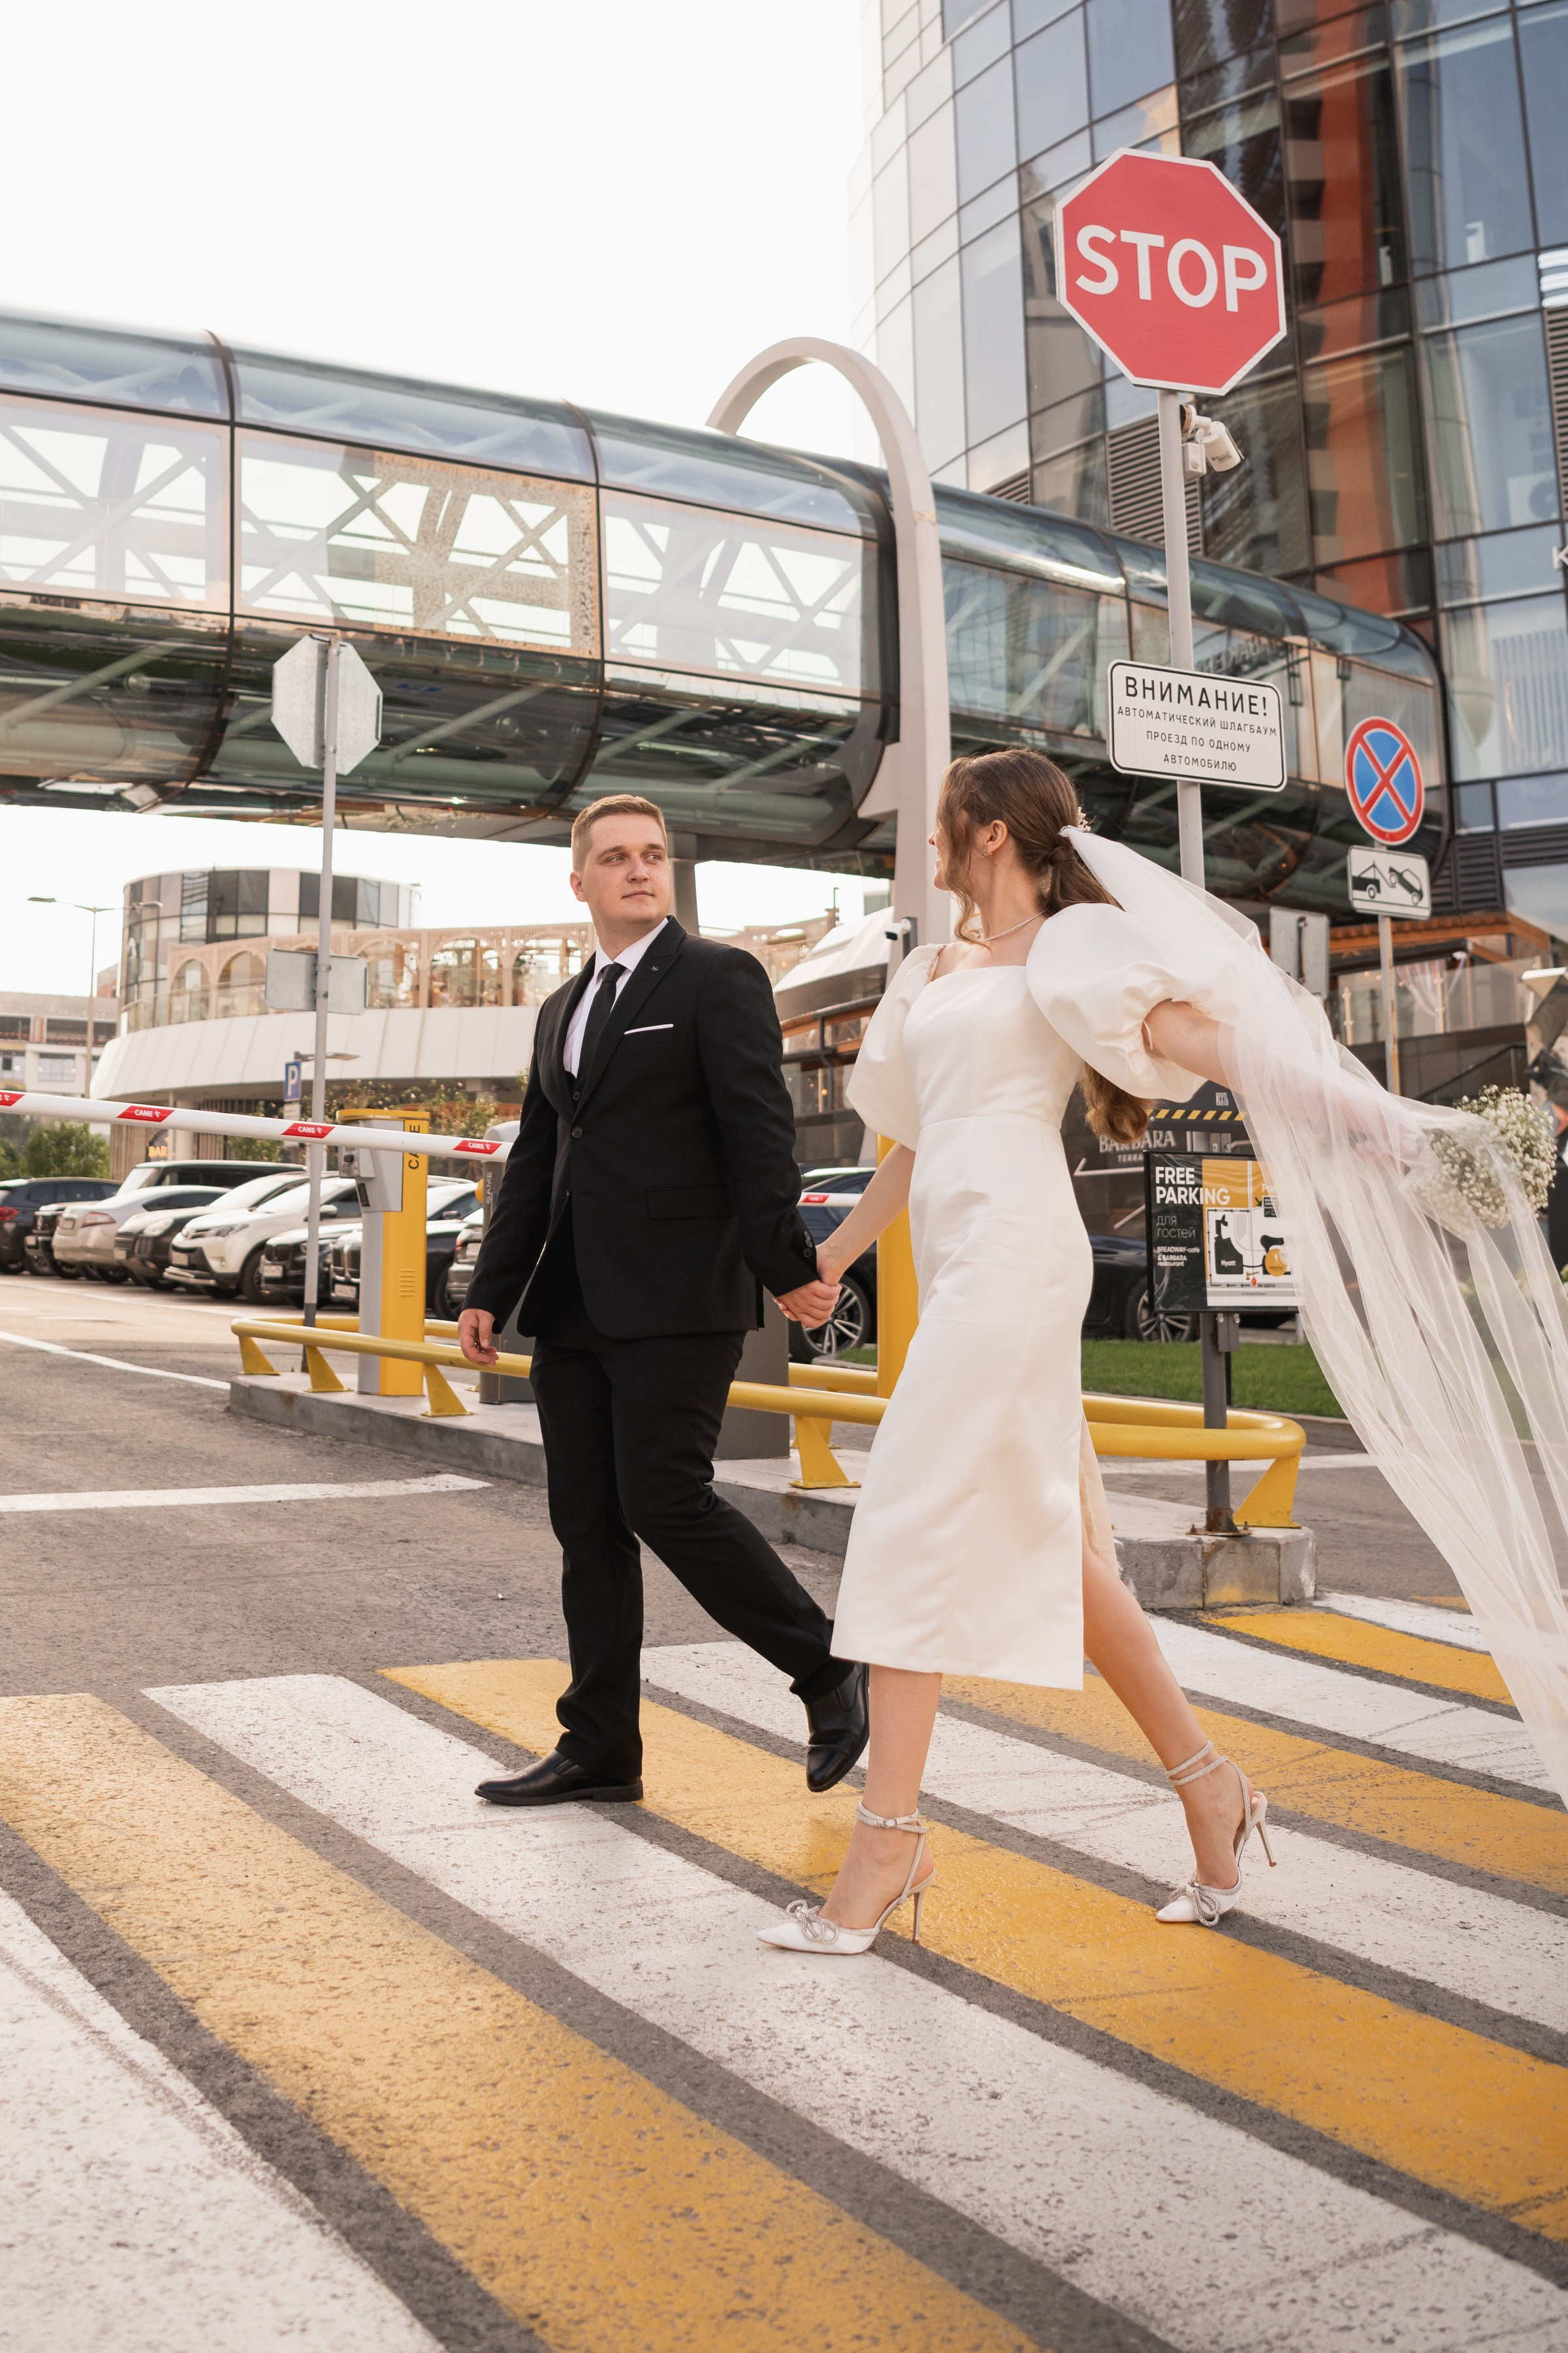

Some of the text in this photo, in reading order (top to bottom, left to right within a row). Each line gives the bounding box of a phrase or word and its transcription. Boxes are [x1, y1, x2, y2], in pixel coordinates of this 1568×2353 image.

[1075, 224, 1268, 312] STOP
[1125, 675, 1267, 717] ВНИМАНИЕ!
[1117, 706, 1277, 737] АВТОМАТИЧЕСКИЙ ШЛАГБАУМ
[1147, 730, 1251, 753] ПРОЕЗД ПО ОДНОМУ
[1163, 753, 1236, 771] АВТОМОБИЛЮ
[288, 1064, 299, 1097] P
[135, 1109, 153, 1118] CAME
[1155, 1166, 1195, 1184] FREE
[1156, 1186, 1230, 1205] PARKING
[1157, 1215, 1176, 1227] для
[1157, 1227, 1196, 1238] гостей
